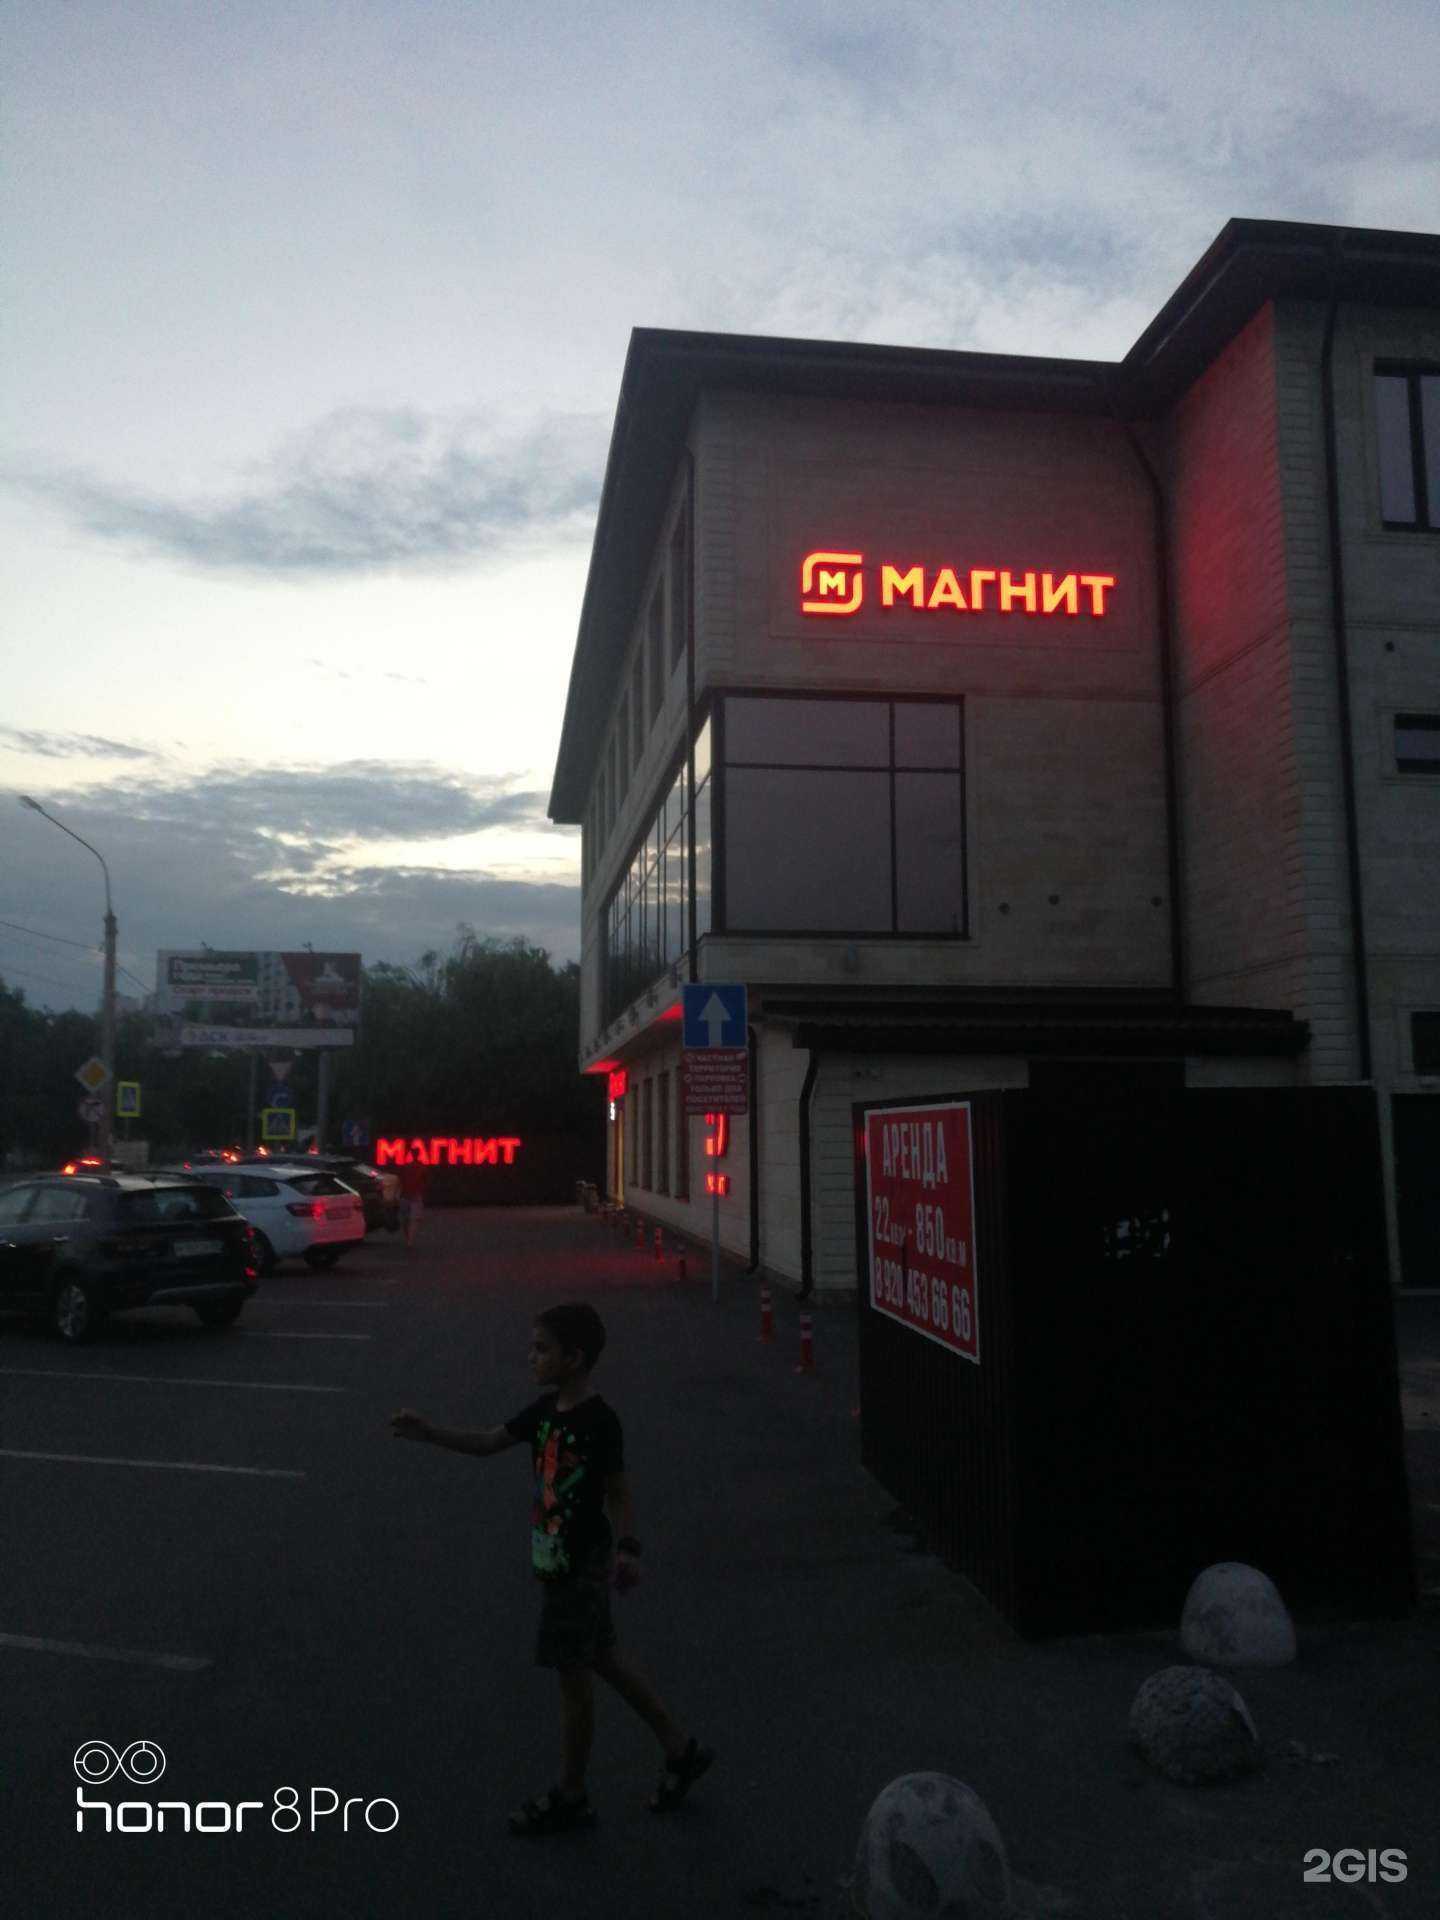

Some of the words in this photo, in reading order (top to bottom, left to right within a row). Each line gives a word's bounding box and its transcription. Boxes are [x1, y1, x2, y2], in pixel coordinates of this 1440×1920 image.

[881, 564, 1115, 616] МАГНИТ
[375, 1136, 521, 1166] МАГНИТ
[882, 1120, 949, 1191] АРЕНДА
[915, 1202, 945, 1261] 850
[931, 1275, 949, 1331] 66
[951, 1284, 971, 1342] 66
